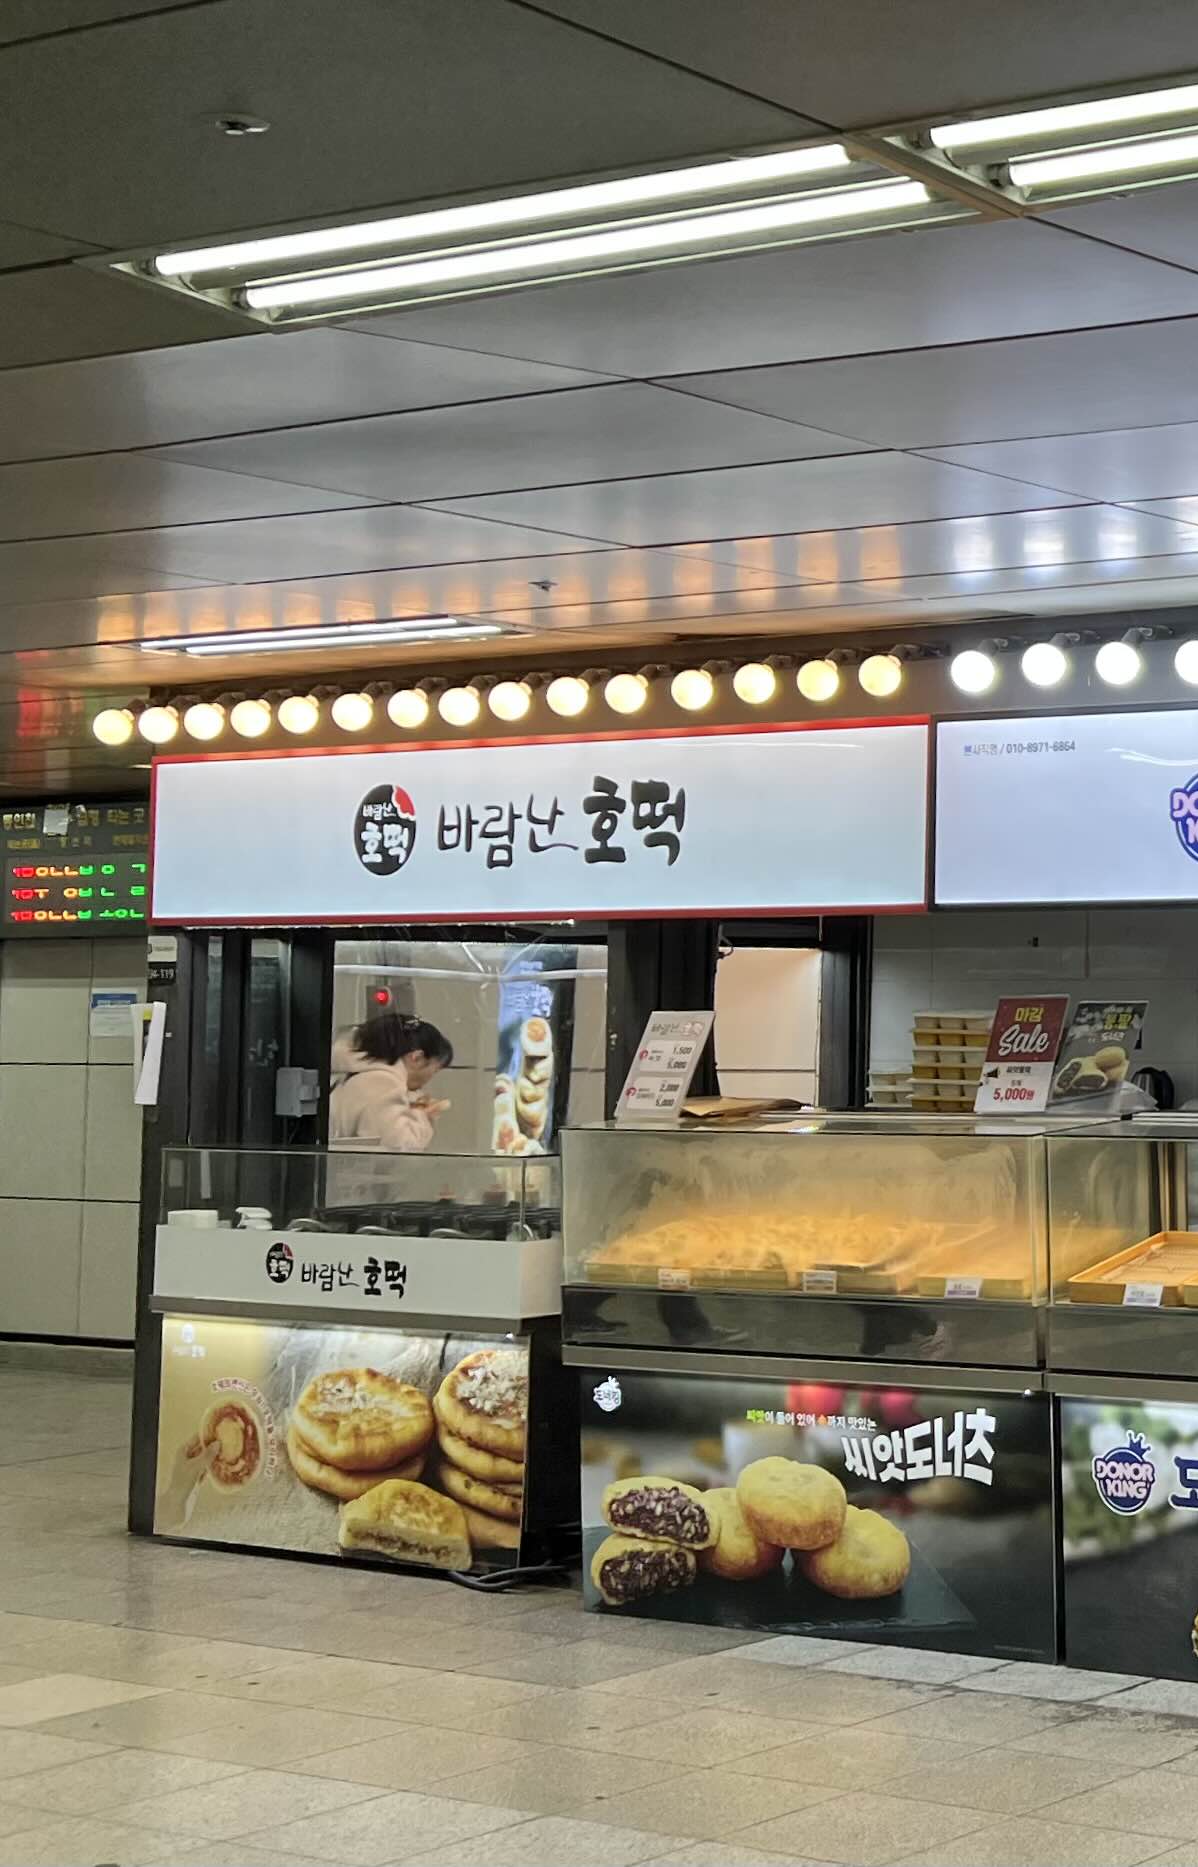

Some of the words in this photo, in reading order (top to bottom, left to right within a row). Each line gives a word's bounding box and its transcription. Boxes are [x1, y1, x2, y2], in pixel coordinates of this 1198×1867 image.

[437, 794, 578, 869] 바람난
[582, 776, 686, 866] 호떡
[361, 822, 409, 863] 호떡
[998, 1024, 1050, 1056] Sale
[301, 1261, 360, 1291] 바람난
[364, 1257, 406, 1299] 호떡
[847, 1416, 877, 1431] 맛있는
[841, 1407, 996, 1485] 씨앗도너츠
[1095, 1457, 1155, 1482] DONOR
[1104, 1477, 1148, 1499] KING
